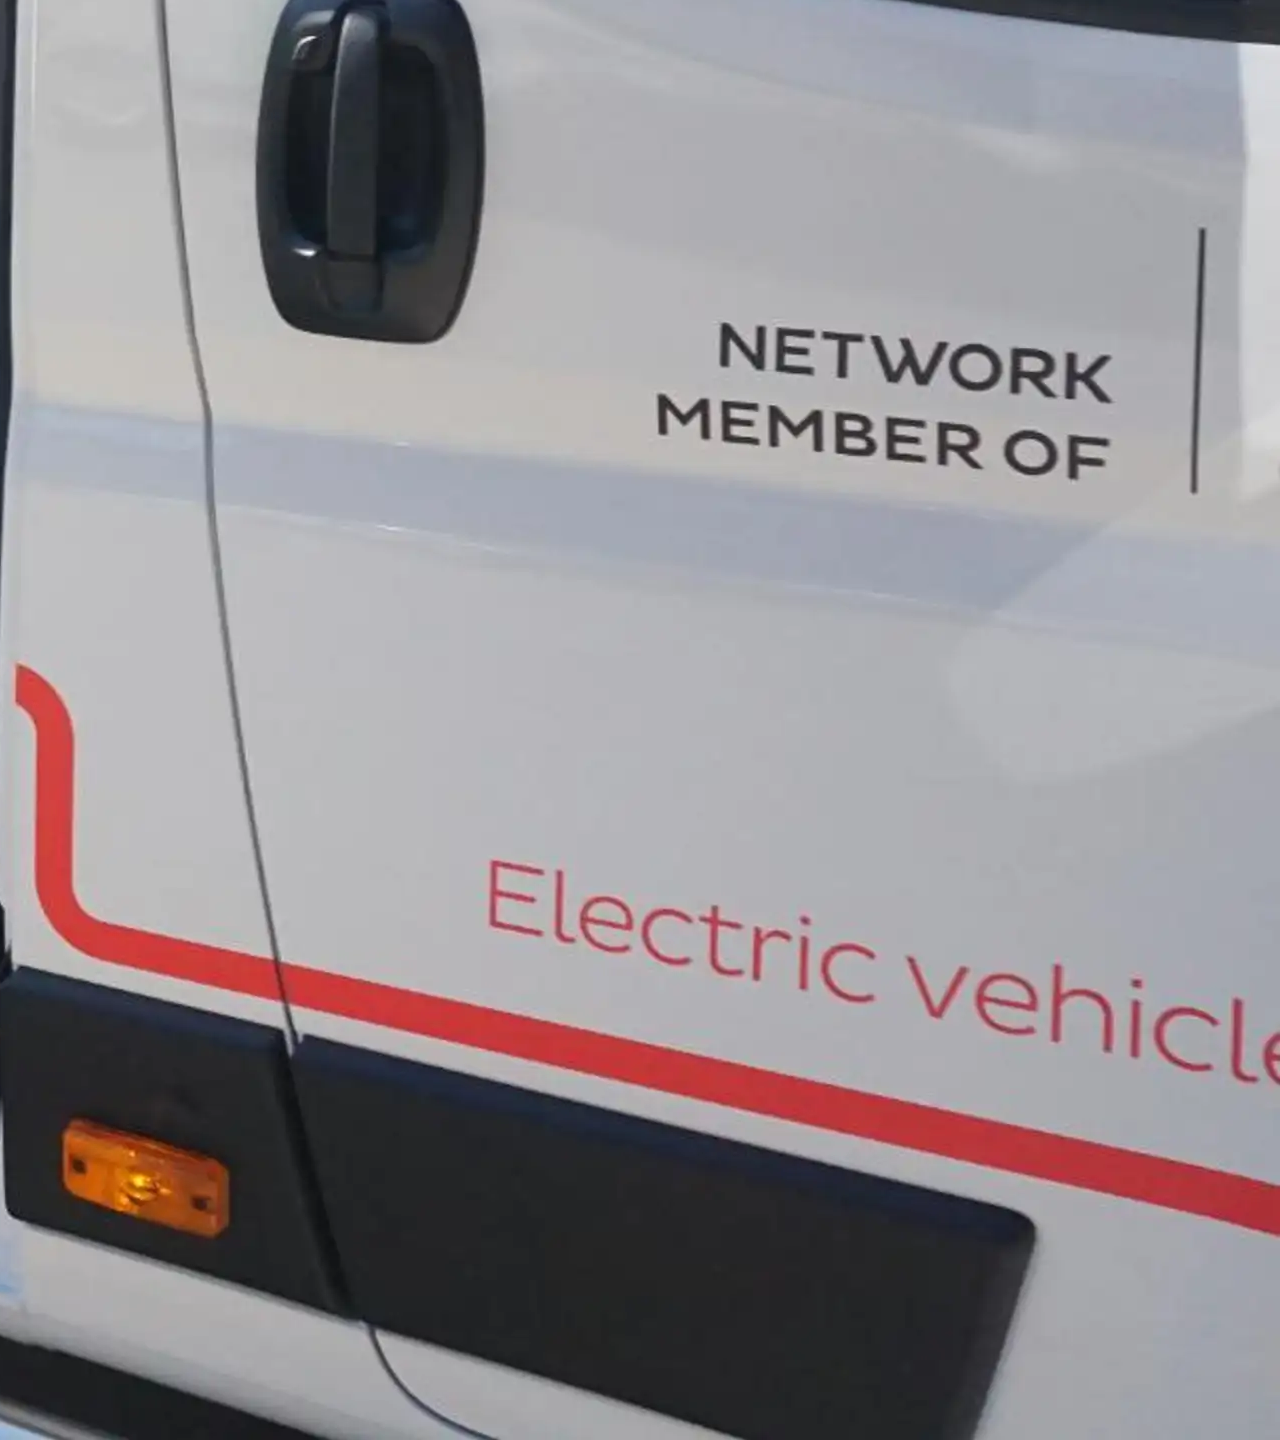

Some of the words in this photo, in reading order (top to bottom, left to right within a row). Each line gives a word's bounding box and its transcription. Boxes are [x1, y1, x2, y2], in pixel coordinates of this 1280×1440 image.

[719, 321, 1113, 403] NETWORK
[656, 393, 984, 470] MEMBER
[1004, 428, 1111, 481] OF
[486, 859, 876, 1003] Electric
[906, 956, 1280, 1086] vehicl
